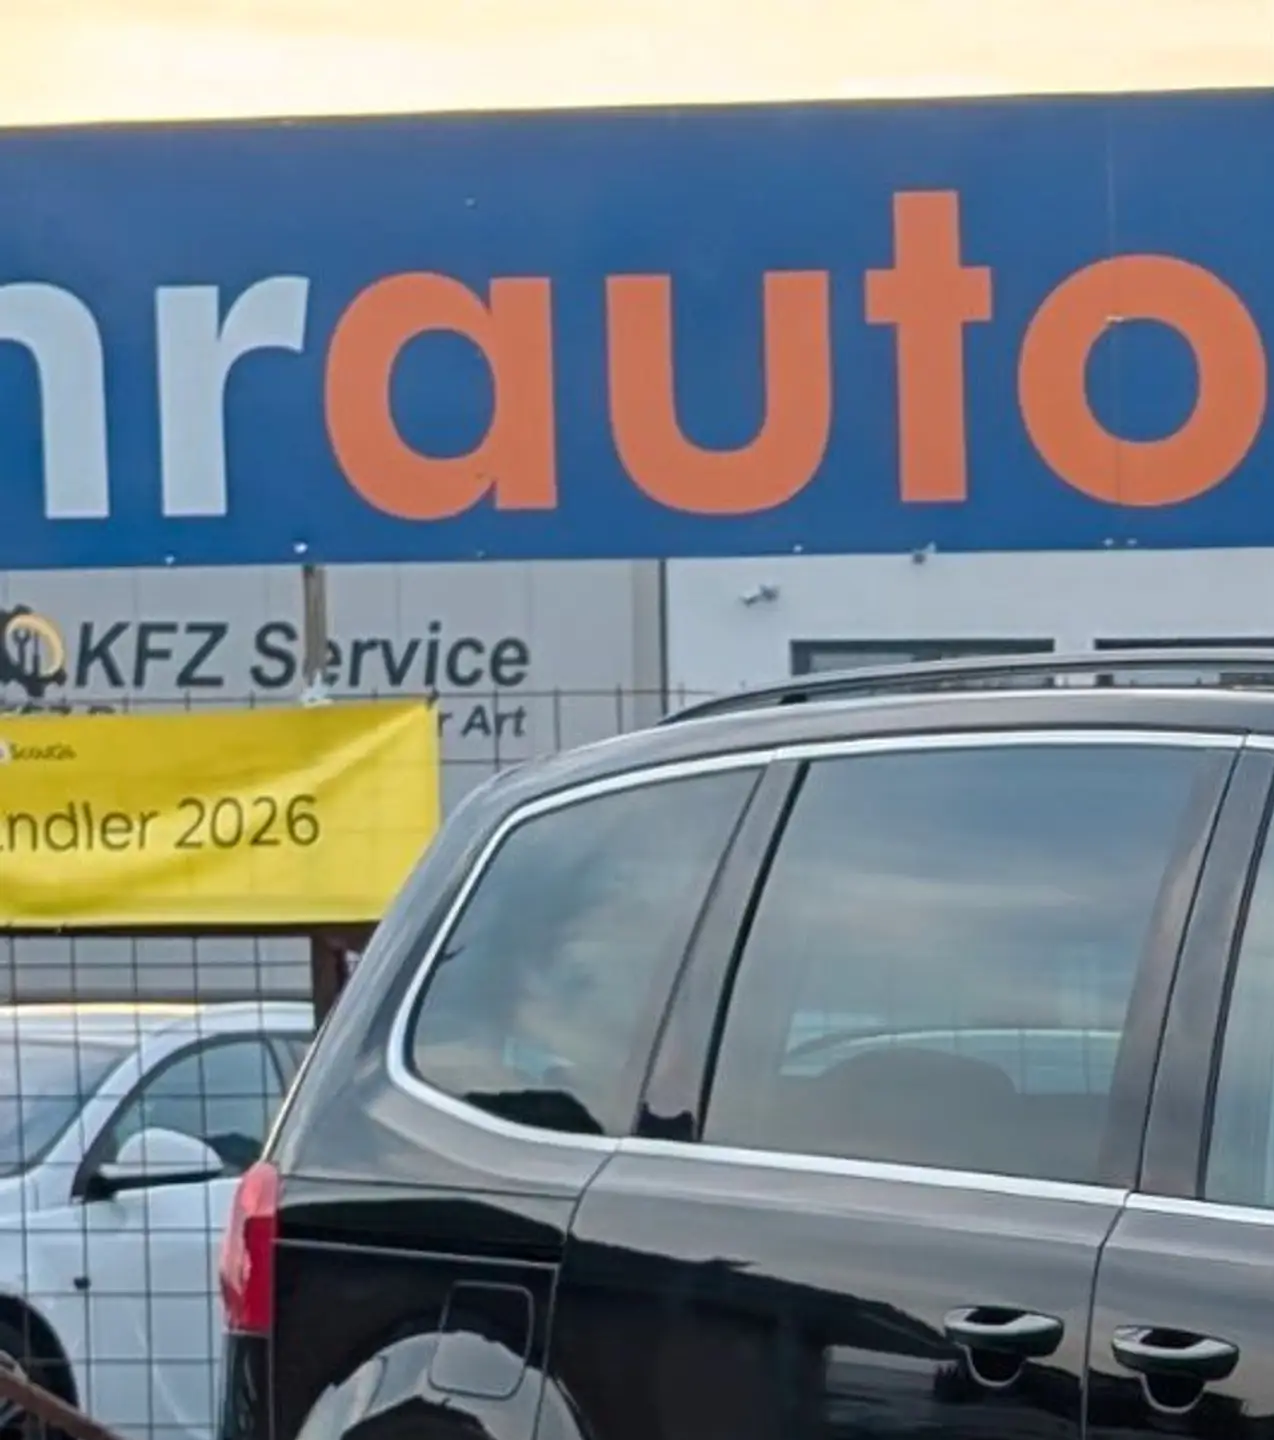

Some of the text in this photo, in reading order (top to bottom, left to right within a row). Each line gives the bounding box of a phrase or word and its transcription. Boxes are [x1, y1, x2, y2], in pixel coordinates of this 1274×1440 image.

[74, 620, 230, 689] KFZ
[461, 704, 525, 738] Art
[0, 796, 321, 852] ndler 2026
